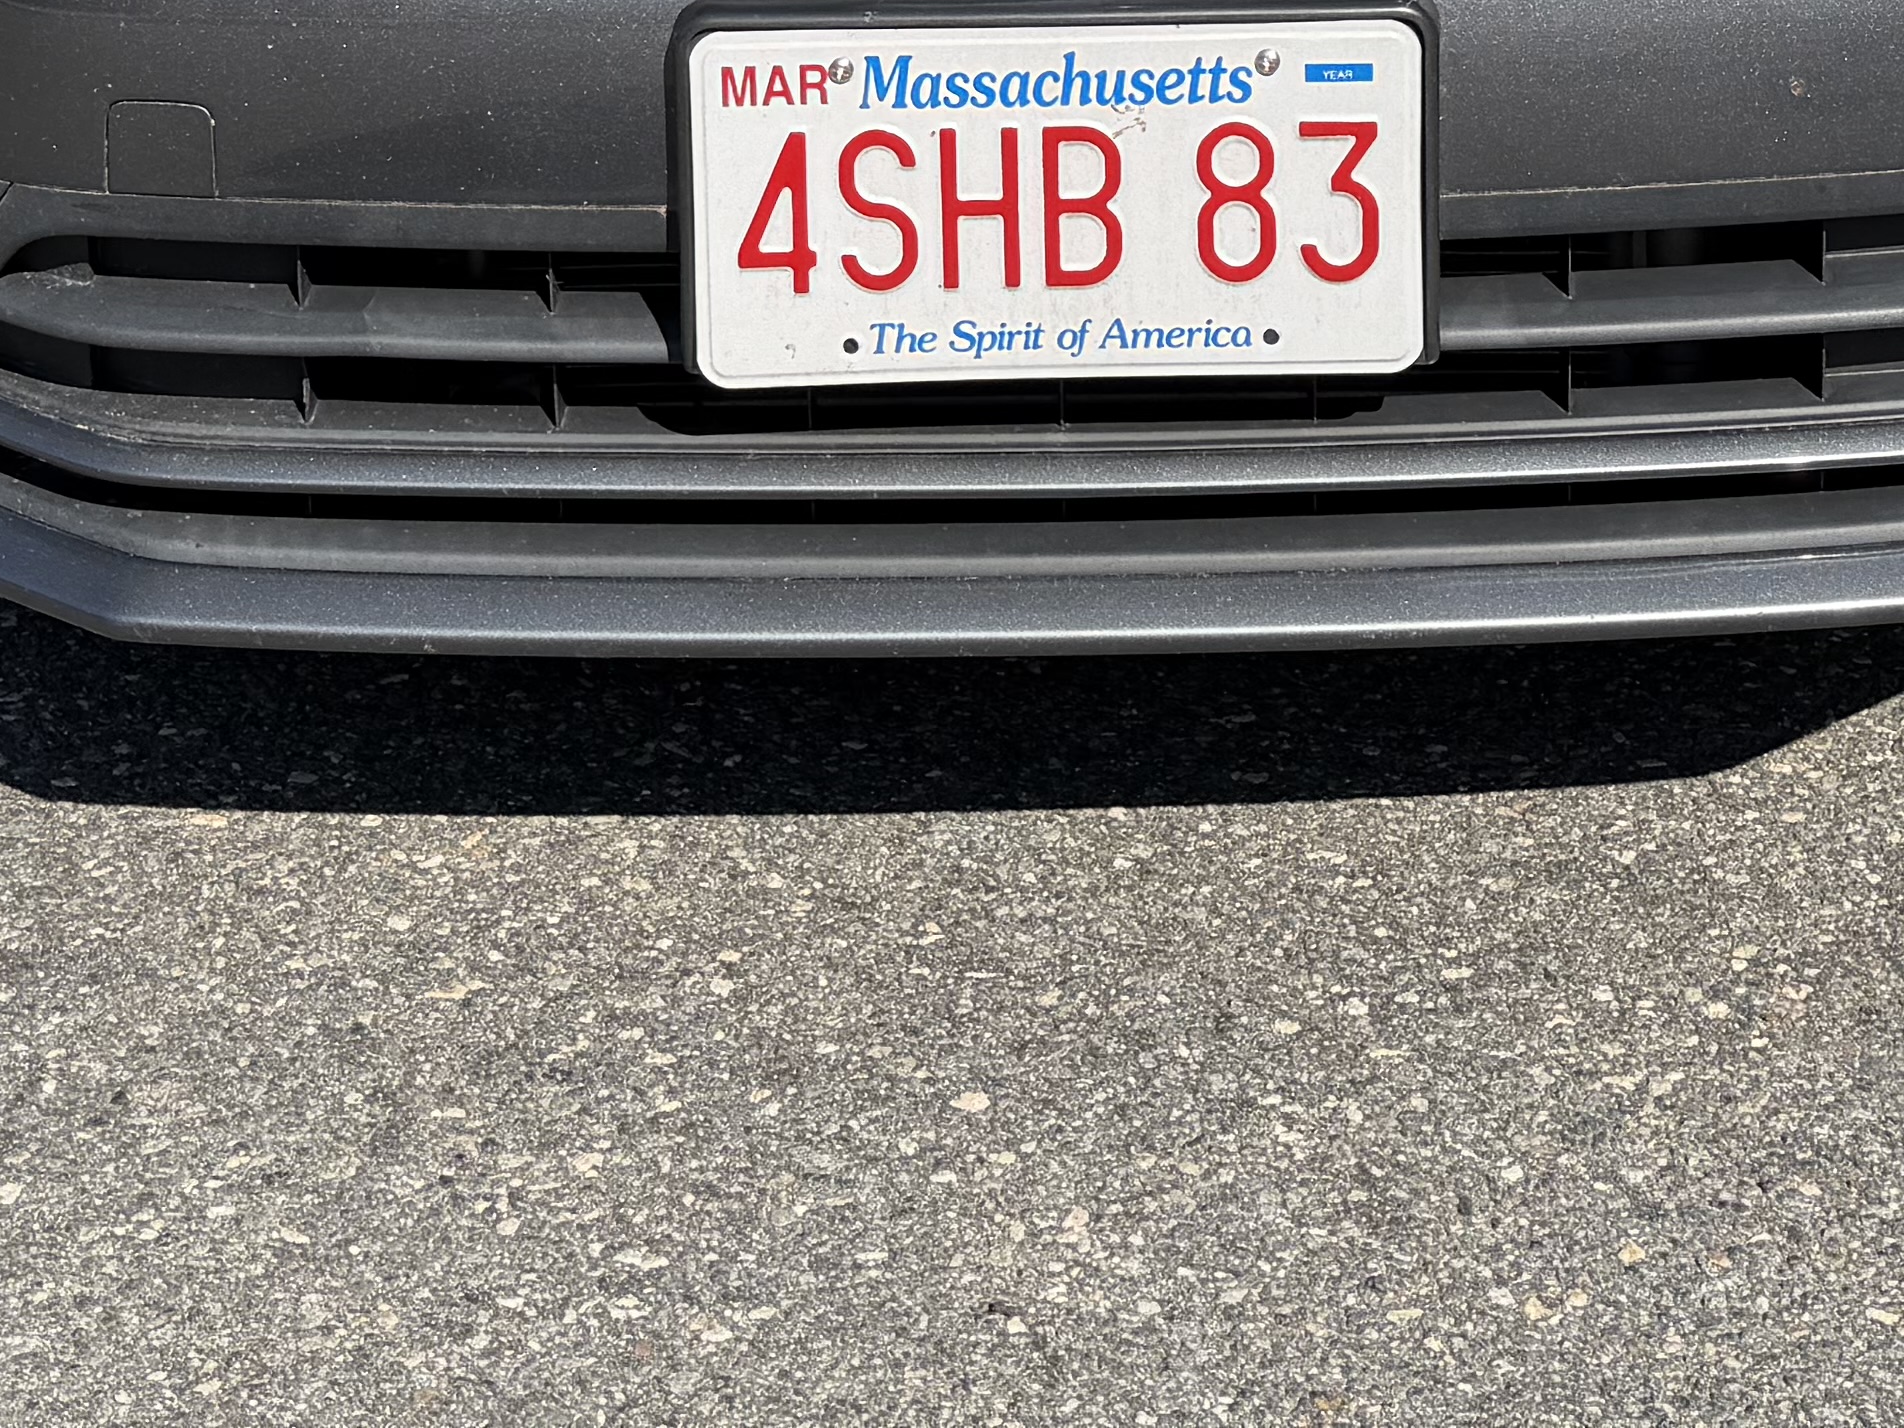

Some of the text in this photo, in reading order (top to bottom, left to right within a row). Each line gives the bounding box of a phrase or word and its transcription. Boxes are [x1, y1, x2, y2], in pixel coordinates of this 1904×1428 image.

[721, 64, 829, 107] MAR
[860, 51, 1253, 110] Massachusetts
[1323, 69, 1354, 81] YEAR
[737, 121, 1380, 294] 4SHB 83
[869, 318, 1253, 359] The Spirit of America
